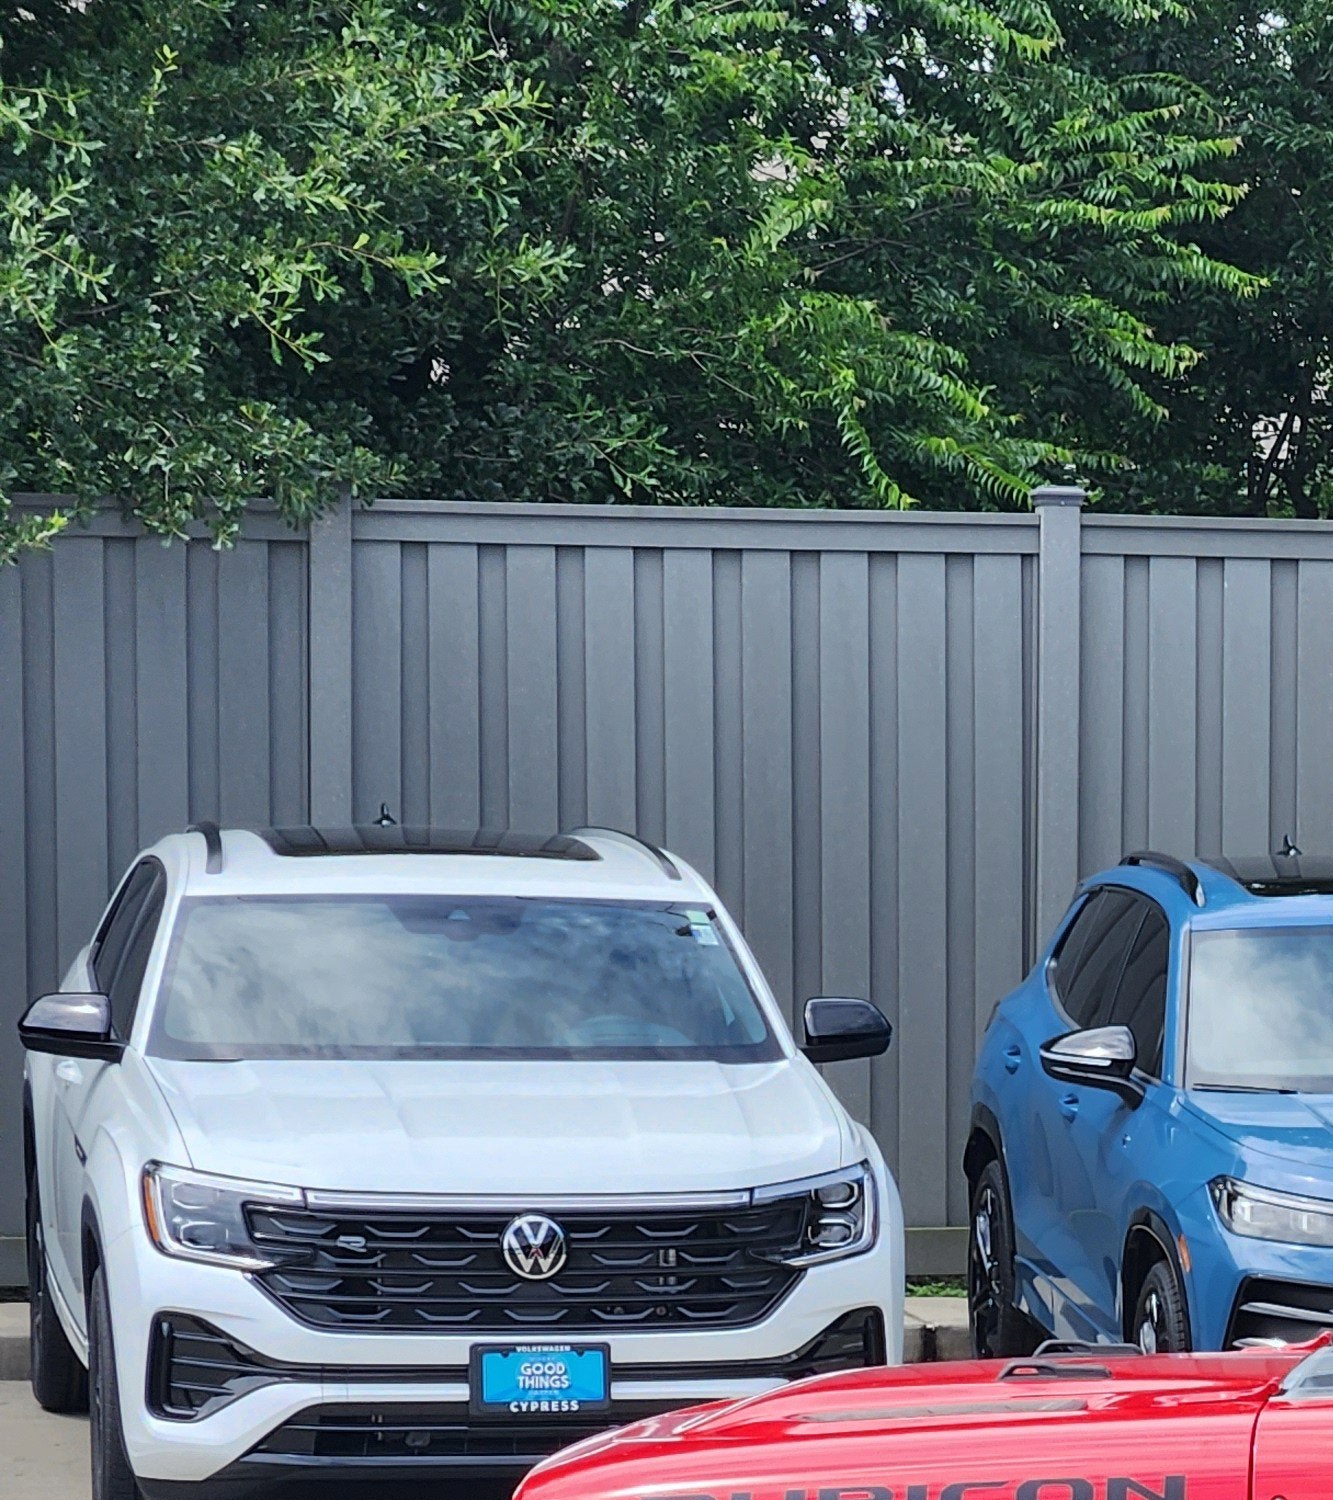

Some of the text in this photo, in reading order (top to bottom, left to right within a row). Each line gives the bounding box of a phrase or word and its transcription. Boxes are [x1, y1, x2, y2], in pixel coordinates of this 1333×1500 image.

[515, 1345, 571, 1353] VOLKSWAGEN
[520, 1362, 566, 1375] GOOD
[517, 1375, 570, 1389] THINGS
[509, 1400, 580, 1413] CYPRESS
